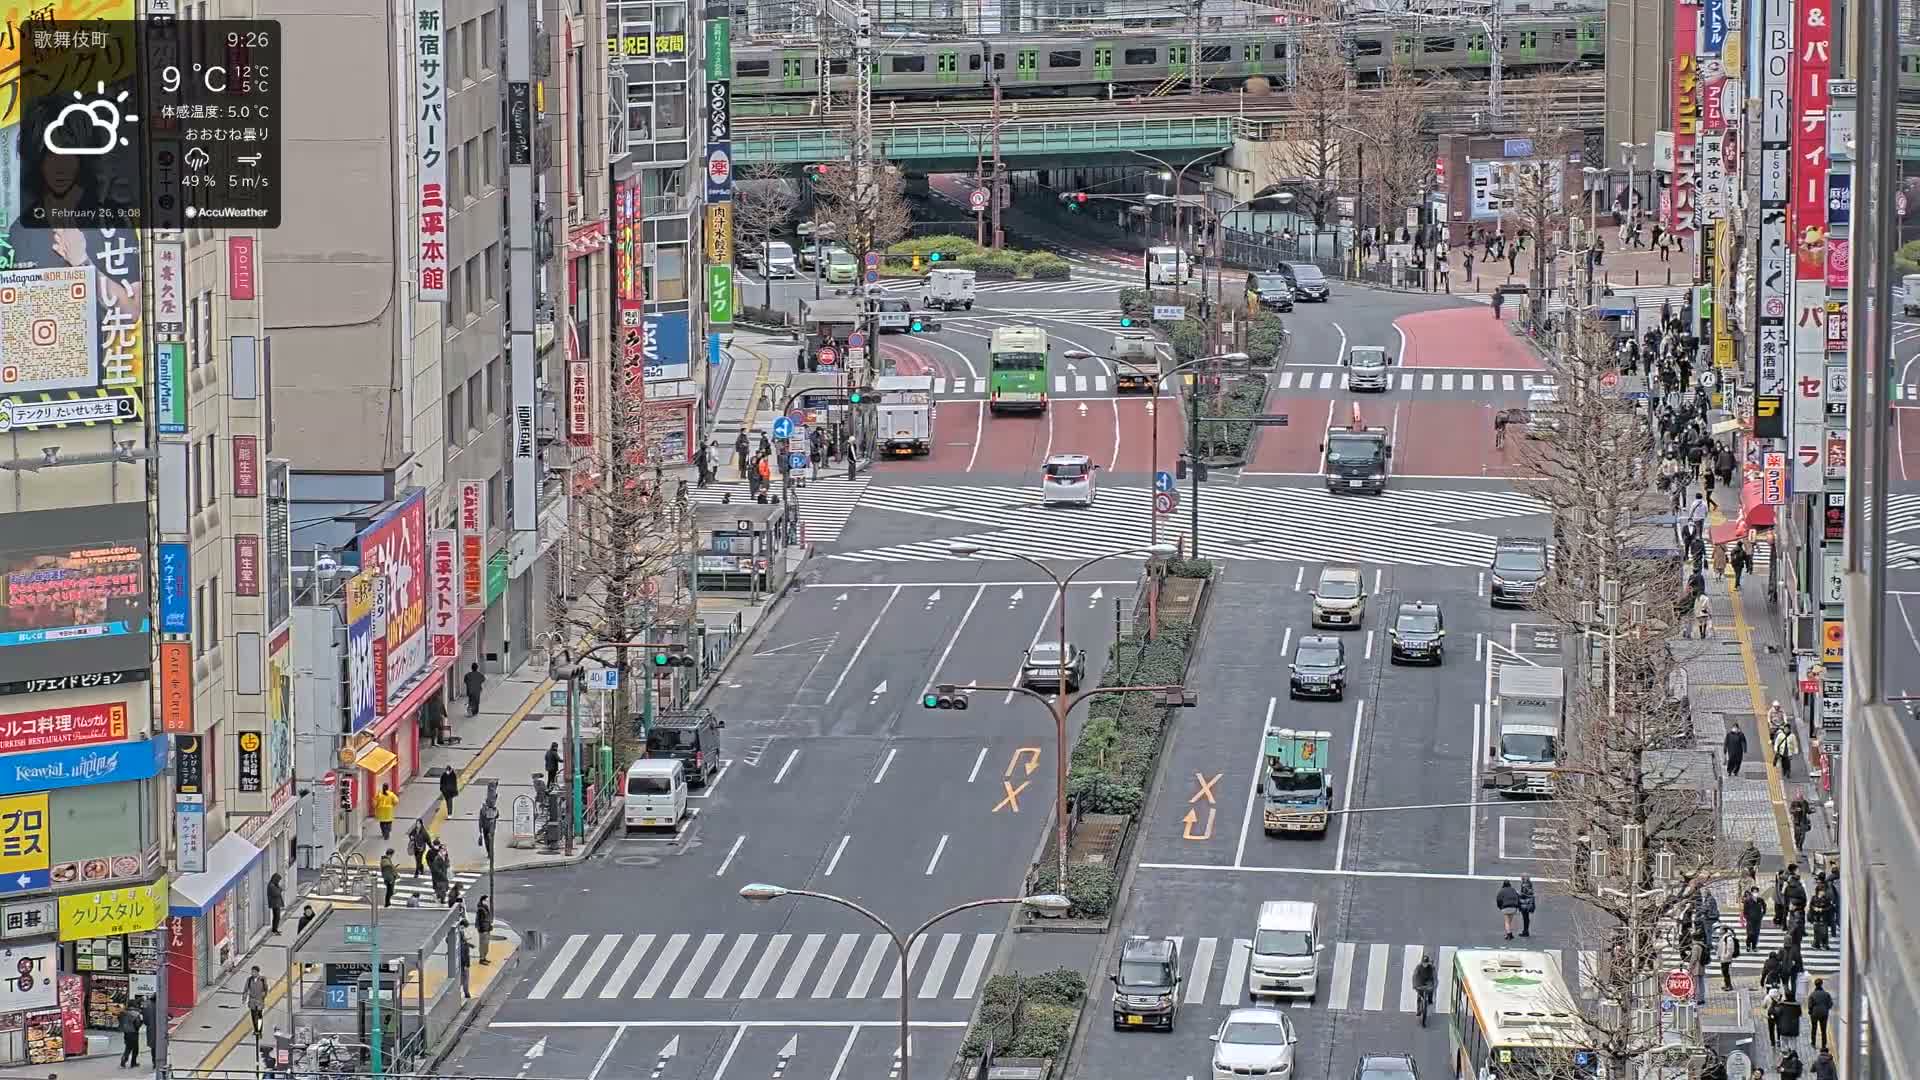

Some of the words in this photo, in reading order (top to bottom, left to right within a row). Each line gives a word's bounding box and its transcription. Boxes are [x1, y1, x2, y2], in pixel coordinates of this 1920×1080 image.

[623, 37, 649, 54] 祝日
[656, 35, 684, 53] 夜間
[419, 10, 441, 168] 新宿サンパーク
[1710, 86, 1721, 119] アコム
[709, 161, 729, 178] 薬
[1772, 151, 1780, 200] ESOLA
[421, 183, 445, 291] 三平本館
[713, 206, 728, 261] 肉汁水餃子
[712, 276, 728, 312] レイク
[161, 323, 178, 332] 3F
[1763, 328, 1776, 381] 大衆酒場
[159, 352, 171, 412] FamilyMart
[1798, 307, 1823, 466] パセラ
[16, 407, 51, 421] テンクリ
[57, 402, 114, 417] たいせい先生
[1832, 403, 1846, 413] 5F
[517, 405, 531, 460] HOMEGAME
[463, 485, 475, 530] GAME
[1831, 495, 1843, 504] 3F
[719, 539, 732, 553] 10
[162, 553, 175, 604] ゲウチャイ
[436, 540, 452, 628] 三平ストア
[26, 673, 123, 693] リアエイドビジョン
[73, 714, 108, 729] パムッカレ
[168, 721, 184, 730] B2
[29, 734, 71, 748] RESTAURANT
[2, 808, 42, 834] プロ
[3, 833, 43, 857] ミス
[7, 910, 42, 930] 囲碁
[72, 902, 145, 926] クリスタル
[328, 990, 345, 1003] 12
